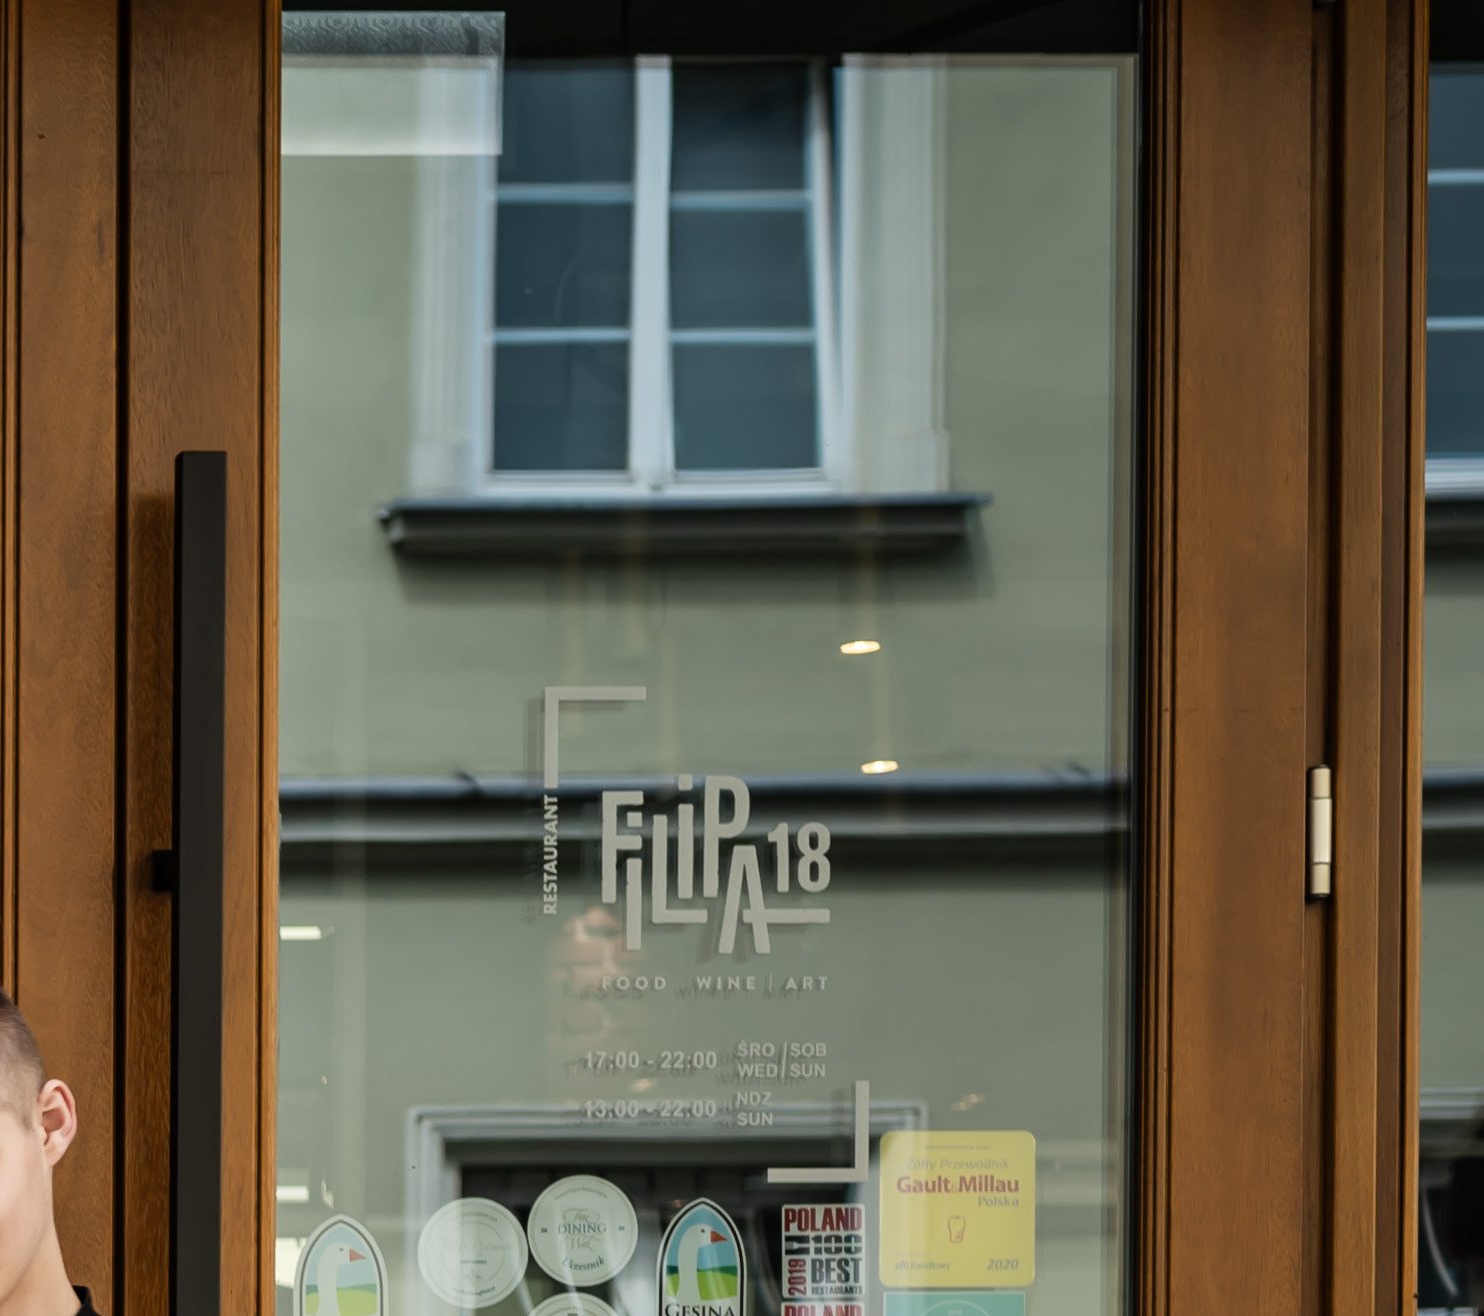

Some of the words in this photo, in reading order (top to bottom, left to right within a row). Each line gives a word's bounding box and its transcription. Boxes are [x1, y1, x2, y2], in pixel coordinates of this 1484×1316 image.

[543, 794, 558, 914] RESTAURANT
[767, 822, 831, 892] 18
[602, 976, 667, 991] FOOD
[696, 976, 756, 991] WINE
[785, 976, 828, 991] ART
[789, 1042, 827, 1057] SOB
[583, 1051, 640, 1069] 17:00
[660, 1051, 717, 1069] 22:00
[738, 1063, 778, 1078] WED
[790, 1063, 826, 1078] SUN
[737, 1091, 772, 1106] NDZ
[660, 1100, 717, 1118] 22:00
[737, 1111, 773, 1127] SUN
[558, 1222, 607, 1234] DINING
[784, 1207, 862, 1232] POLAND
[811, 1235, 862, 1255] 100
[811, 1258, 862, 1284] BEST
[986, 1258, 1019, 1271] 2020
